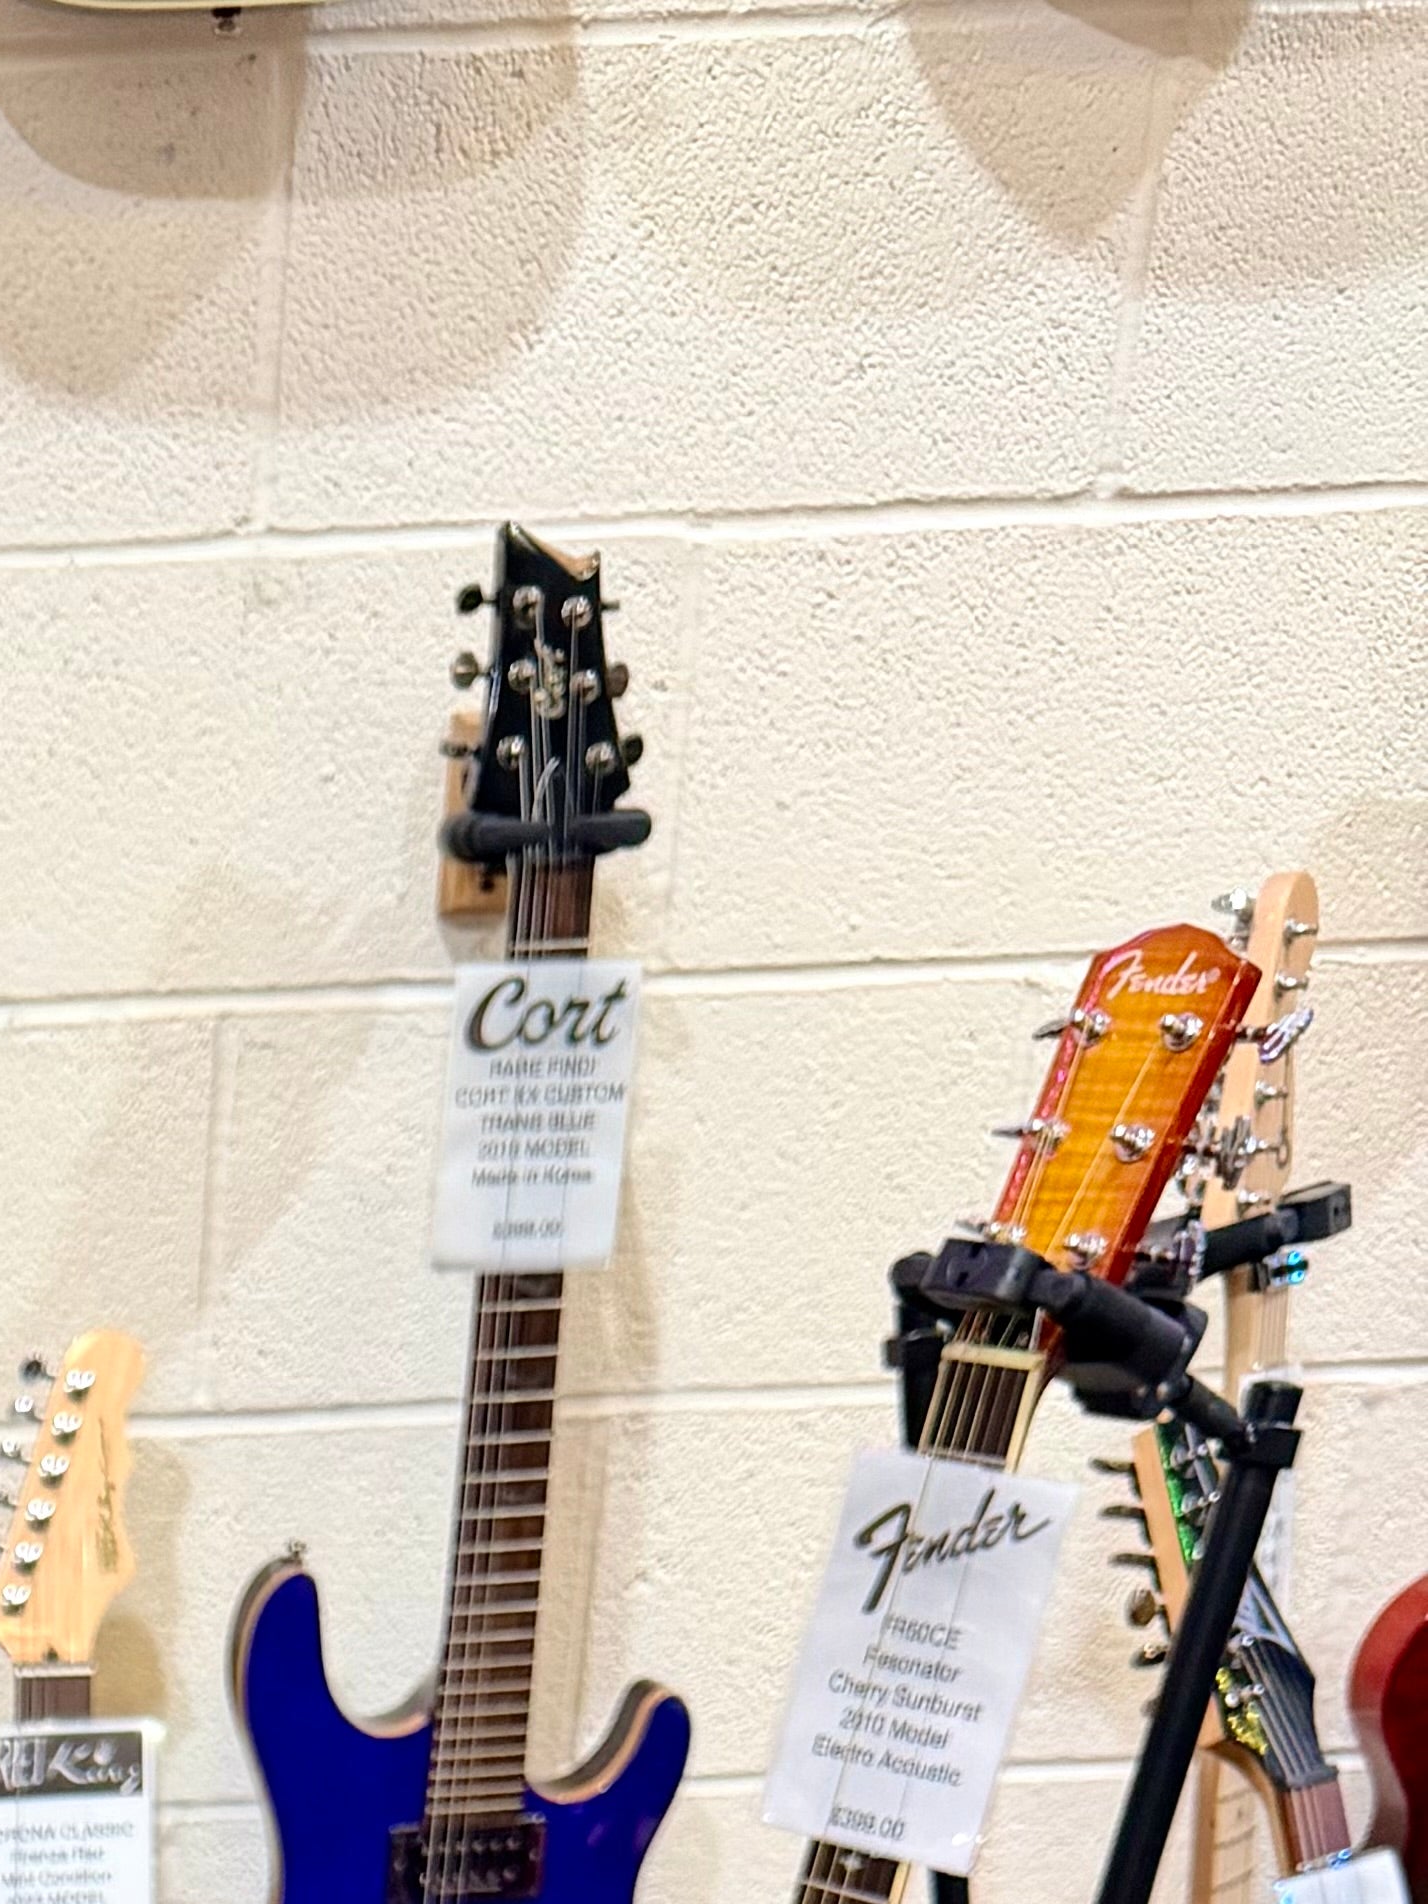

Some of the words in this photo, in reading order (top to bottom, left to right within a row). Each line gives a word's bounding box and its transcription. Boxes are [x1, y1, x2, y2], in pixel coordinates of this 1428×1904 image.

[1107, 950, 1210, 999] Fender
[465, 976, 629, 1053] Cort
[523, 1140, 590, 1160] MODEL
[852, 1486, 1051, 1614] Fender
[863, 1646, 963, 1683] Resonator
[828, 1670, 890, 1709] Cherry
[892, 1683, 983, 1723] Sunburst
[888, 1717, 952, 1750] Model
[812, 1734, 873, 1767] Electro
[878, 1747, 963, 1788] Acoustic
